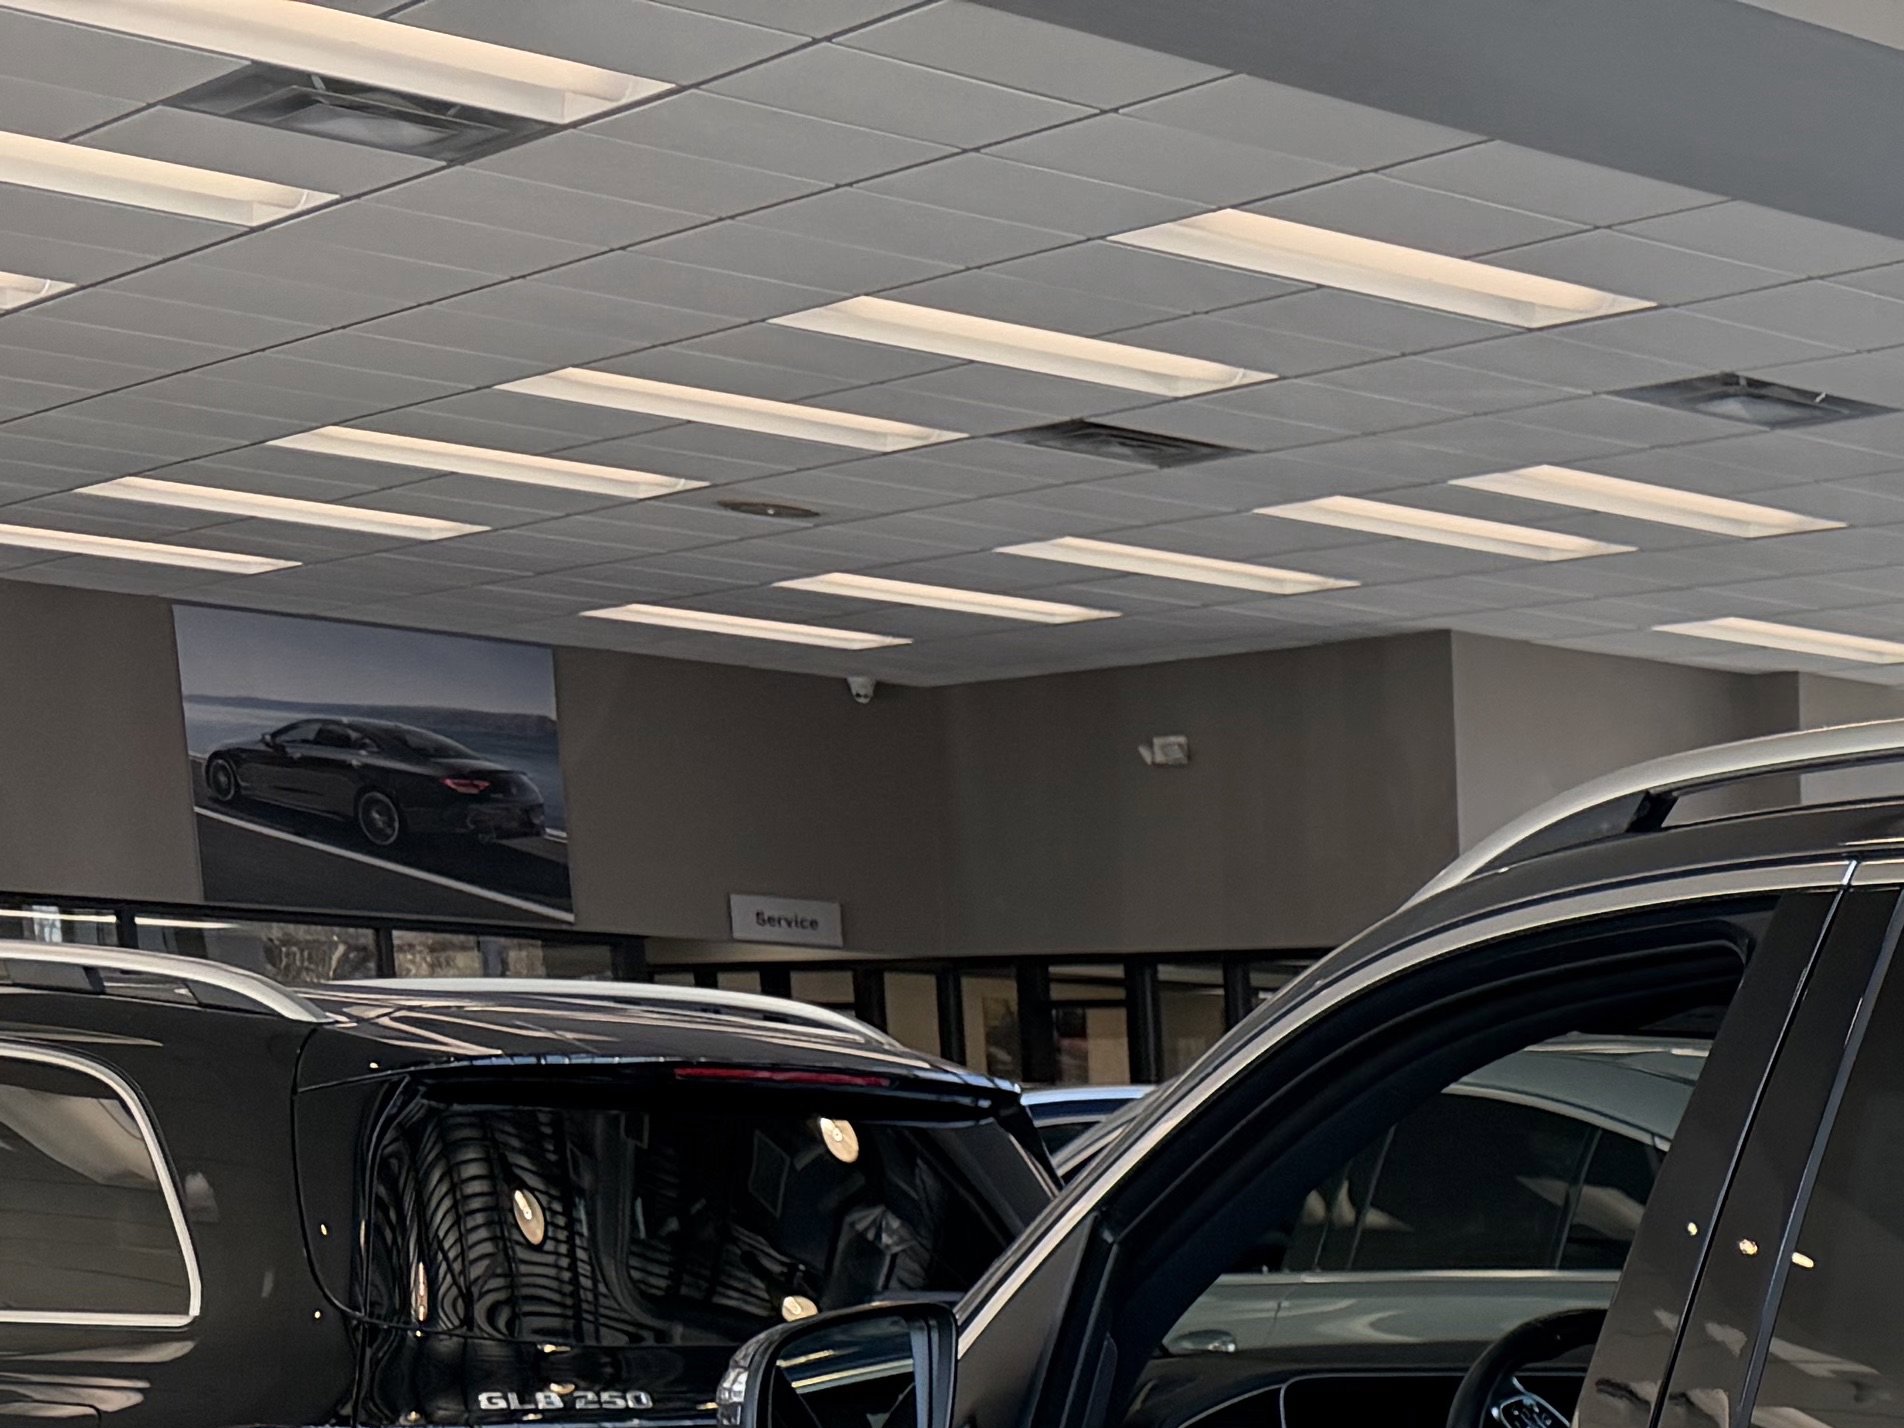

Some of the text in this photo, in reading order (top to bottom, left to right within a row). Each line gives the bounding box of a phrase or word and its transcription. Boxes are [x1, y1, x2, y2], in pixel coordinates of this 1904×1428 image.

[755, 910, 819, 931] Service
[478, 1390, 653, 1410] GLB 250
